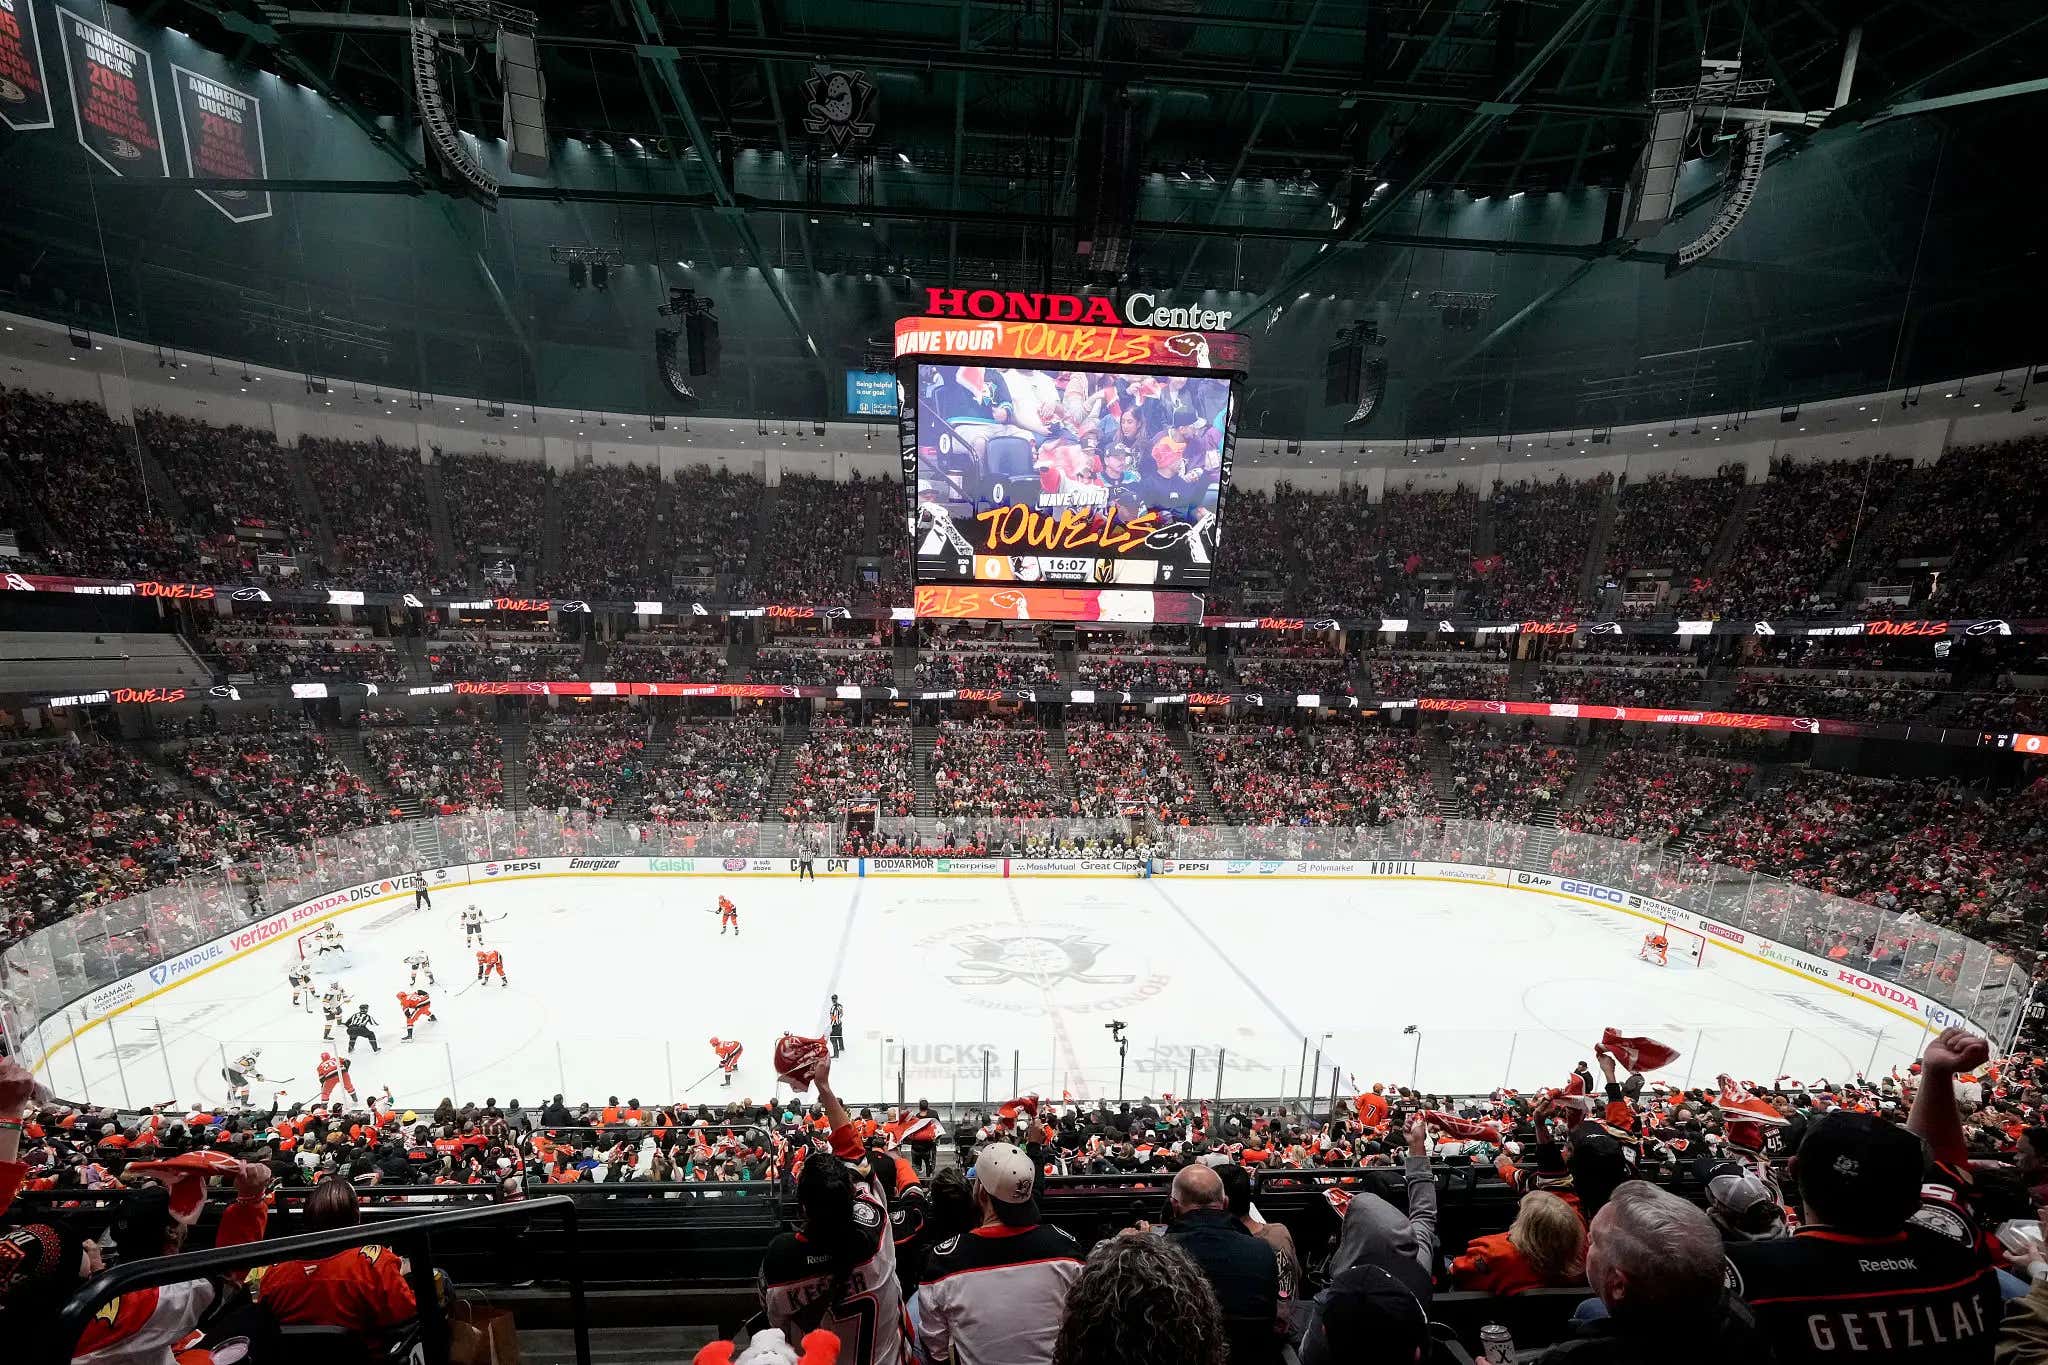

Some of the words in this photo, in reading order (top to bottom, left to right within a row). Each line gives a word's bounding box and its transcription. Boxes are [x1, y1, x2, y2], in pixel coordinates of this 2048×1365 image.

[75, 21, 137, 66] ANAHEIM
[85, 43, 133, 79] DUCKS
[88, 62, 137, 101] 2016
[188, 77, 247, 111] ANAHEIM
[198, 94, 243, 124] DUCKS
[925, 287, 1122, 326] HONDA
[1125, 293, 1233, 331] Center
[945, 327, 995, 352] YOUR
[1006, 323, 1152, 363] TOWELS
[1039, 493, 1071, 507] WAVE
[977, 503, 1158, 552] TOWELS
[985, 558, 1001, 578] 0
[1049, 560, 1087, 571] 16:07
[1163, 571, 1171, 580] 9
[103, 586, 132, 595] YOUR
[136, 582, 215, 598] TOWELS
[494, 598, 550, 611] TOWELS
[766, 605, 815, 617] TOWELS
[1260, 618, 1304, 629] TOWELS
[1520, 622, 1577, 633] TOWELS
[1834, 626, 1860, 635] YOUR
[1866, 620, 1948, 636] TOWELS
[454, 682, 509, 694] TOWELS
[957, 688, 1002, 700] TOWELS
[50, 697, 78, 707] WAVE
[79, 693, 106, 704] YOUR
[112, 688, 185, 703] TOWELS
[1188, 692, 1231, 705] TOWELS
[1419, 699, 1467, 712] TOWELS
[1680, 714, 1700, 722] YOUR
[1703, 712, 1769, 728] TOWELS
[504, 862, 541, 872] PEPSI
[569, 857, 620, 871] Energizer
[649, 858, 695, 872] Kalshi
[827, 858, 850, 872] CAT
[874, 859, 934, 869] BODYARMOR
[1025, 863, 1076, 871] MassMutual
[1081, 861, 1110, 870] Great
[1113, 861, 1137, 872] Clips
[1179, 863, 1209, 871] PEPSI
[1309, 863, 1354, 873] Polymarket
[1439, 869, 1486, 880] AstraZeneca
[350, 876, 418, 902] DISCOVER
[1561, 881, 1623, 904] GEICO
[292, 895, 349, 922] HONDA
[1643, 899, 1690, 920] NORWEGIAN
[230, 916, 288, 951] verizon
[1708, 923, 1744, 943] CHIPOTLE
[170, 946, 223, 975] FANDUEL
[1759, 946, 1828, 977] DRAFTKINGS
[1837, 970, 1919, 1011] HONDA
[1366, 1104, 1376, 1118] 7
[1767, 1135, 1782, 1152] 45
[1859, 1257, 1918, 1273] Reebok
[1807, 1294, 1984, 1351] GETZLAF
